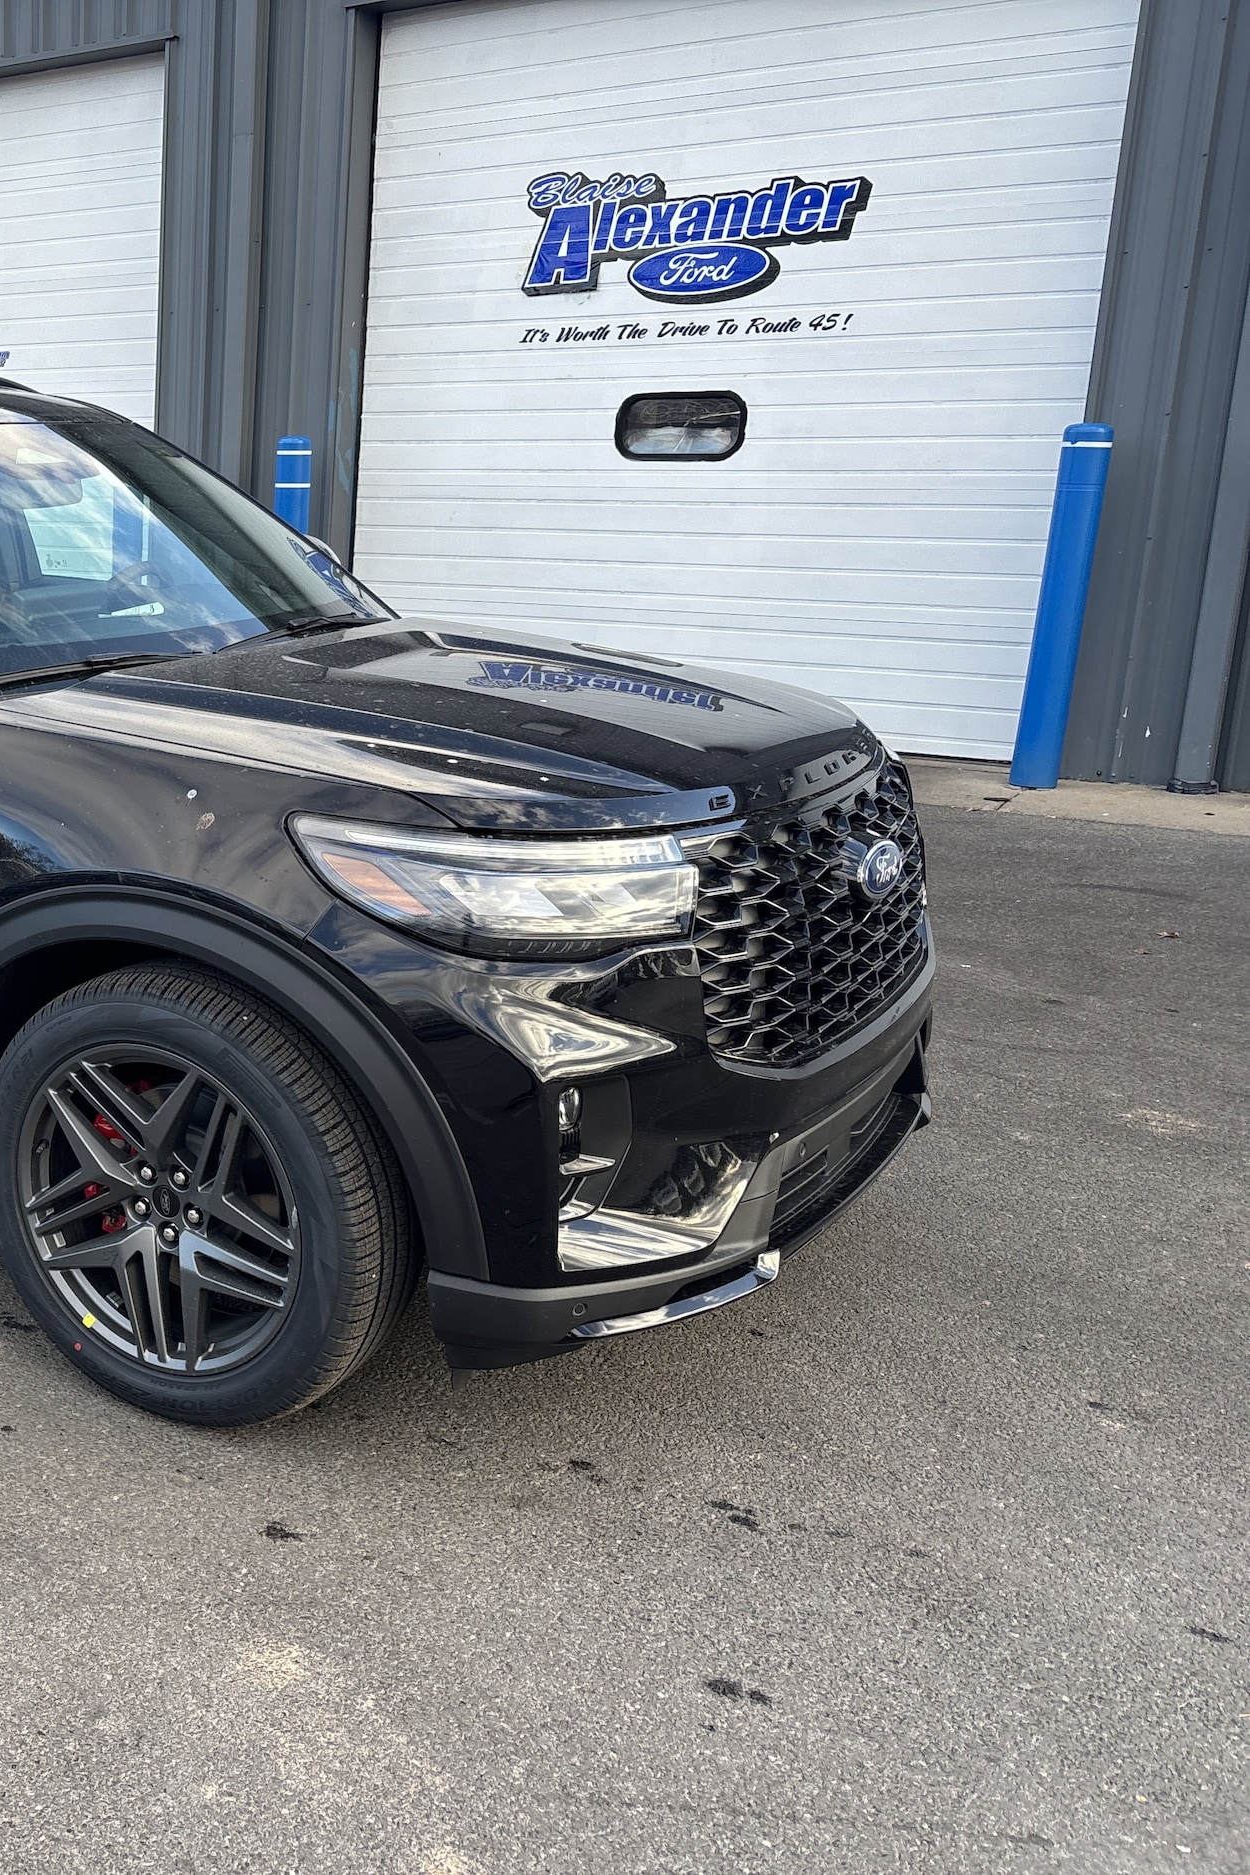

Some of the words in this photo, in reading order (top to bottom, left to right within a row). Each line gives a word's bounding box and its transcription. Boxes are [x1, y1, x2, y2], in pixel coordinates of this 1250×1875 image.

[529, 174, 657, 210] Blaise
[524, 177, 861, 287] Alexander
[659, 251, 738, 286] Ford
[519, 327, 550, 344] It's
[555, 324, 611, 343] Worth
[617, 322, 648, 340] The
[657, 320, 710, 338] Drive
[717, 318, 739, 336] To
[745, 316, 801, 335] Route
[809, 313, 854, 331] 45!
